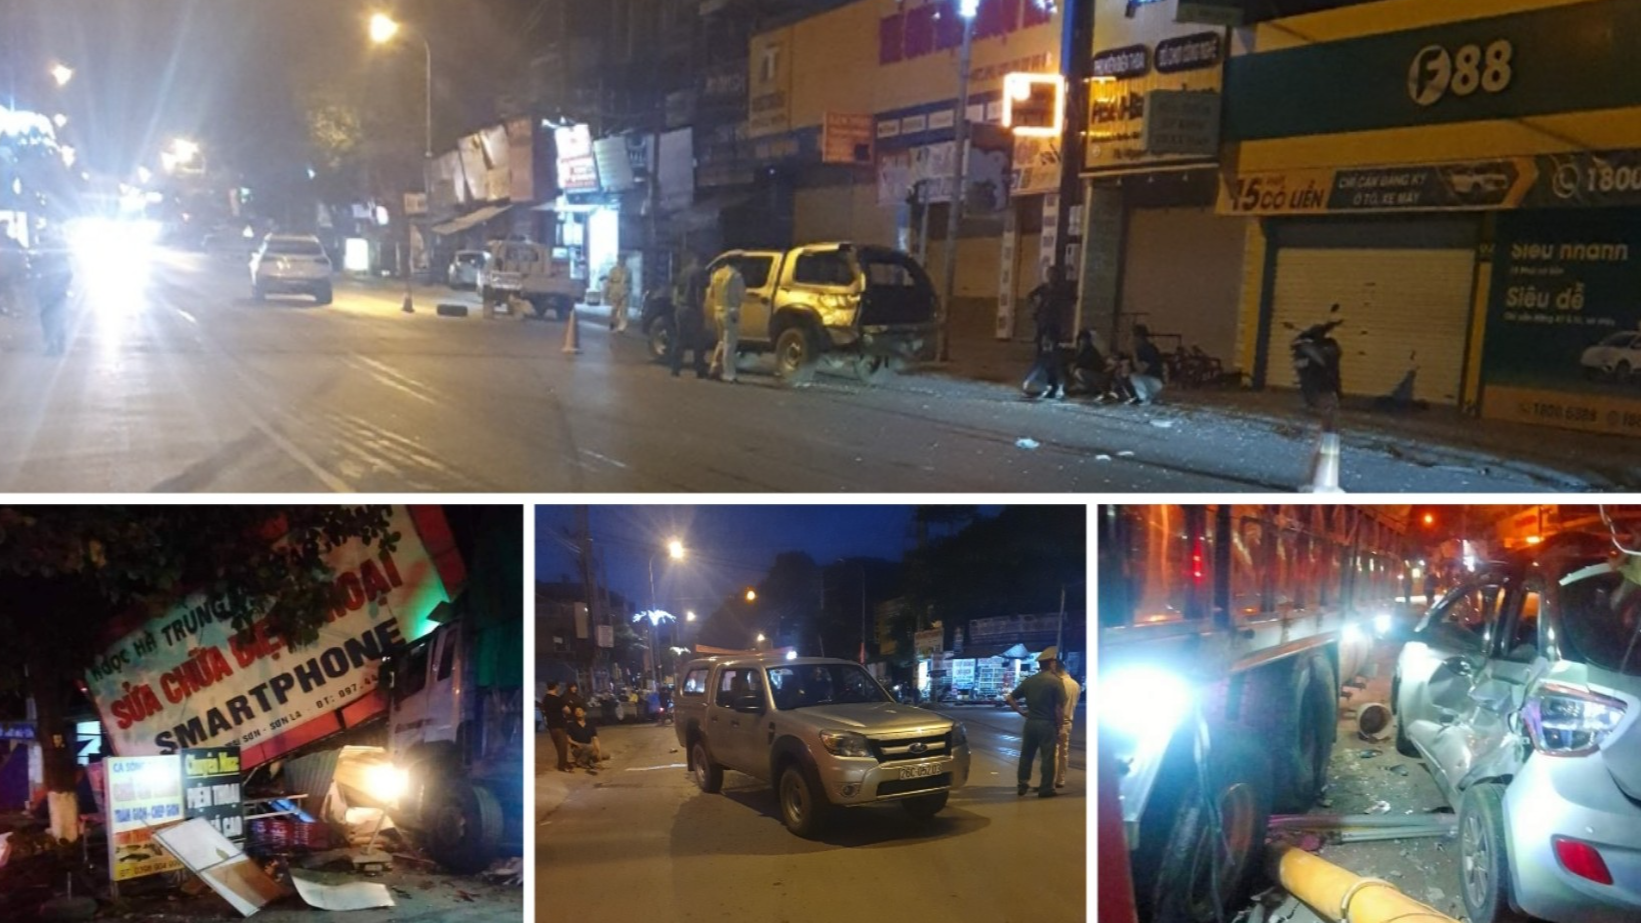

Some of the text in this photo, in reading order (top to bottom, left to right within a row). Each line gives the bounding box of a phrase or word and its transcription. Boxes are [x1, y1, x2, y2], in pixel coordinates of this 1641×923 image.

[1505, 285, 1550, 309] Siêu
[111, 681, 163, 730] SỬA
[160, 646, 234, 704] CHỮA
[155, 616, 407, 755] SMARTPHONE
